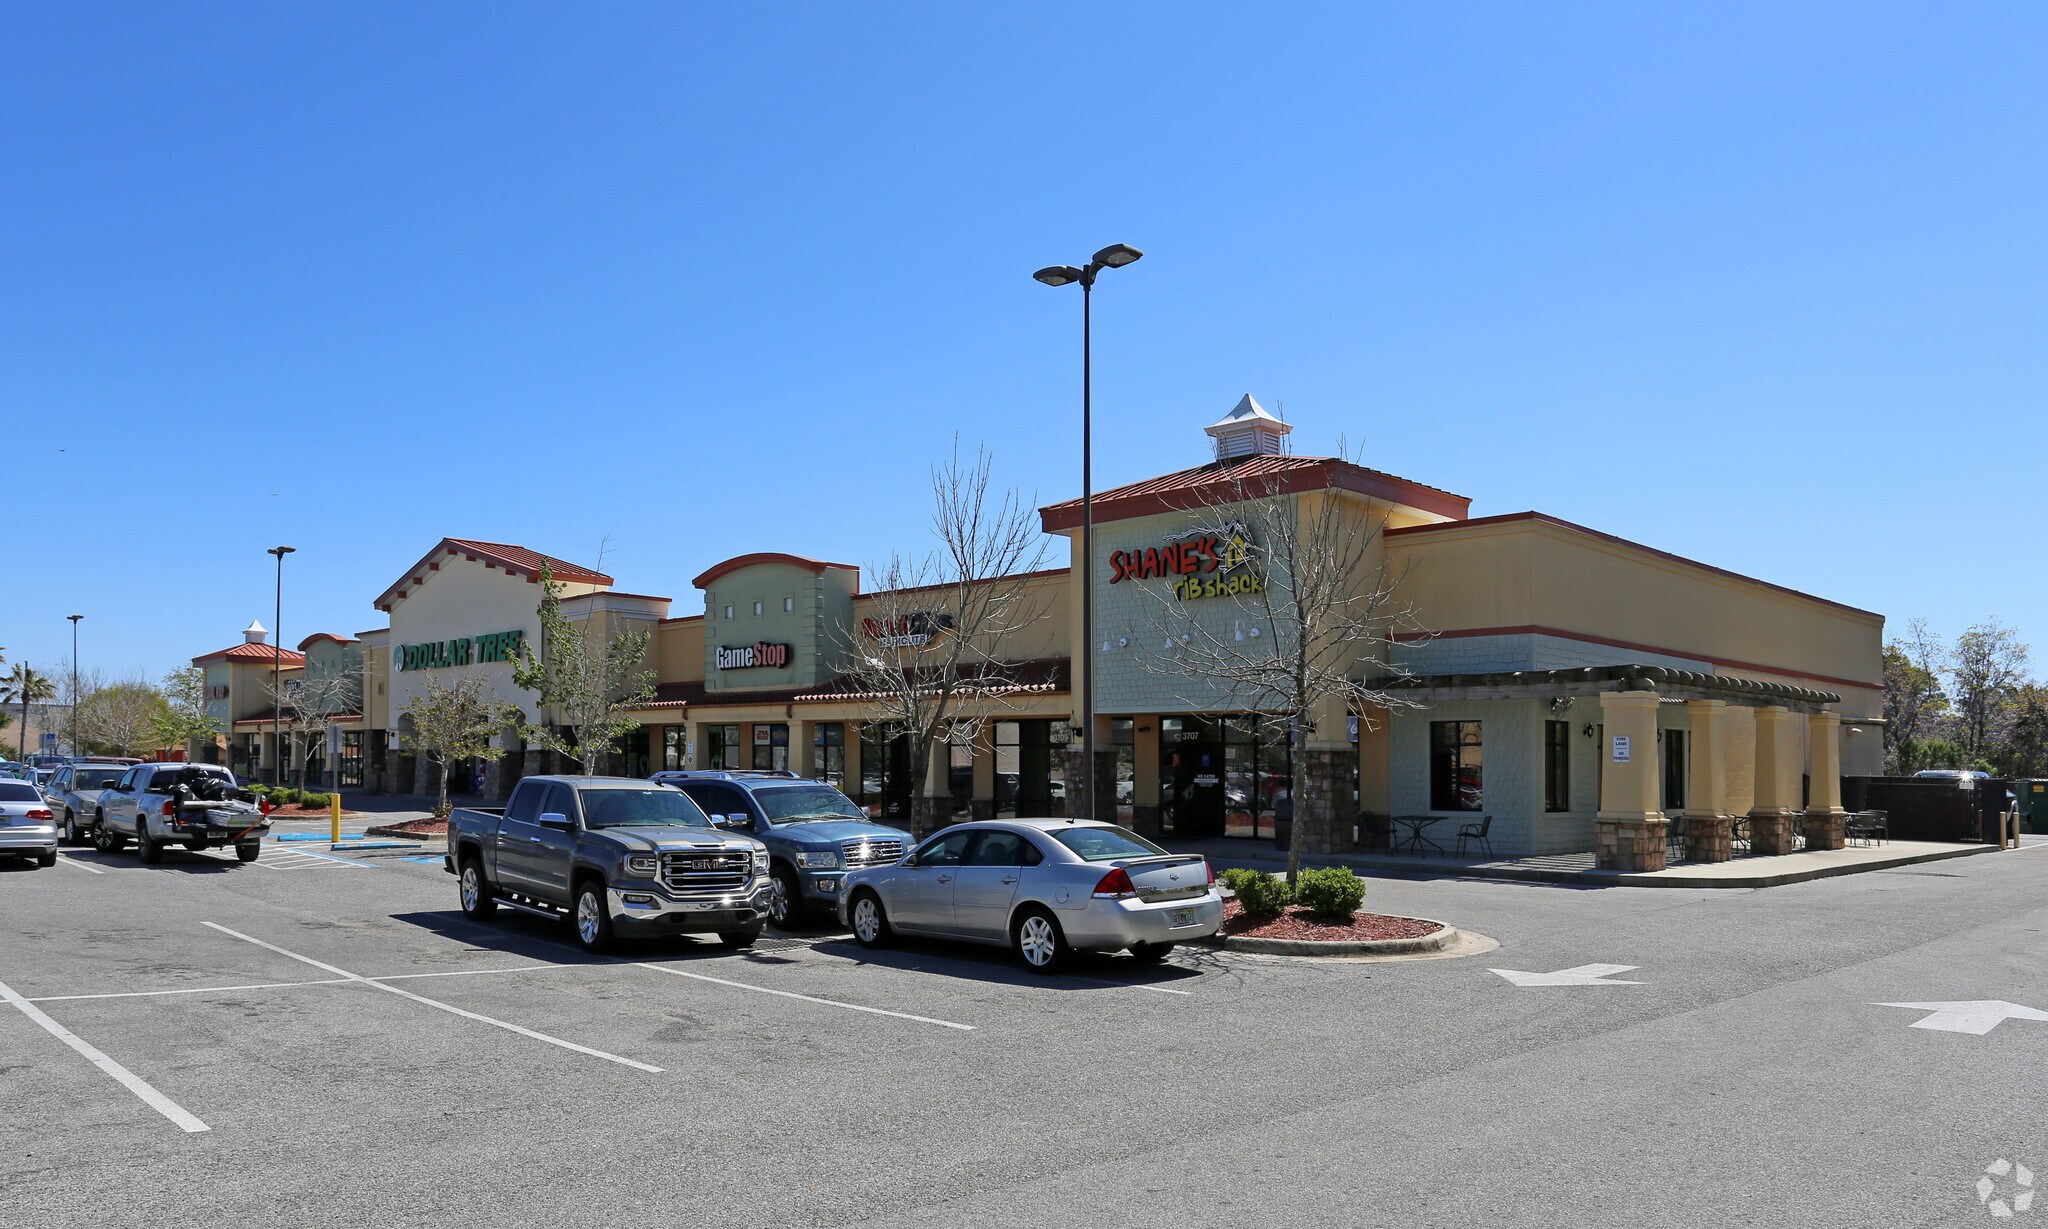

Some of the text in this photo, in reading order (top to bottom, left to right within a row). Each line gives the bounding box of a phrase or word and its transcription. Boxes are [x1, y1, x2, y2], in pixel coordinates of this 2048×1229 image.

[1109, 536, 1220, 584] SHANE'S
[1205, 572, 1264, 598] shack
[407, 630, 522, 671] DOLLAR TREE
[715, 641, 790, 670] GameStop
[1182, 732, 1199, 740] 3707
[691, 858, 728, 870] GMC
